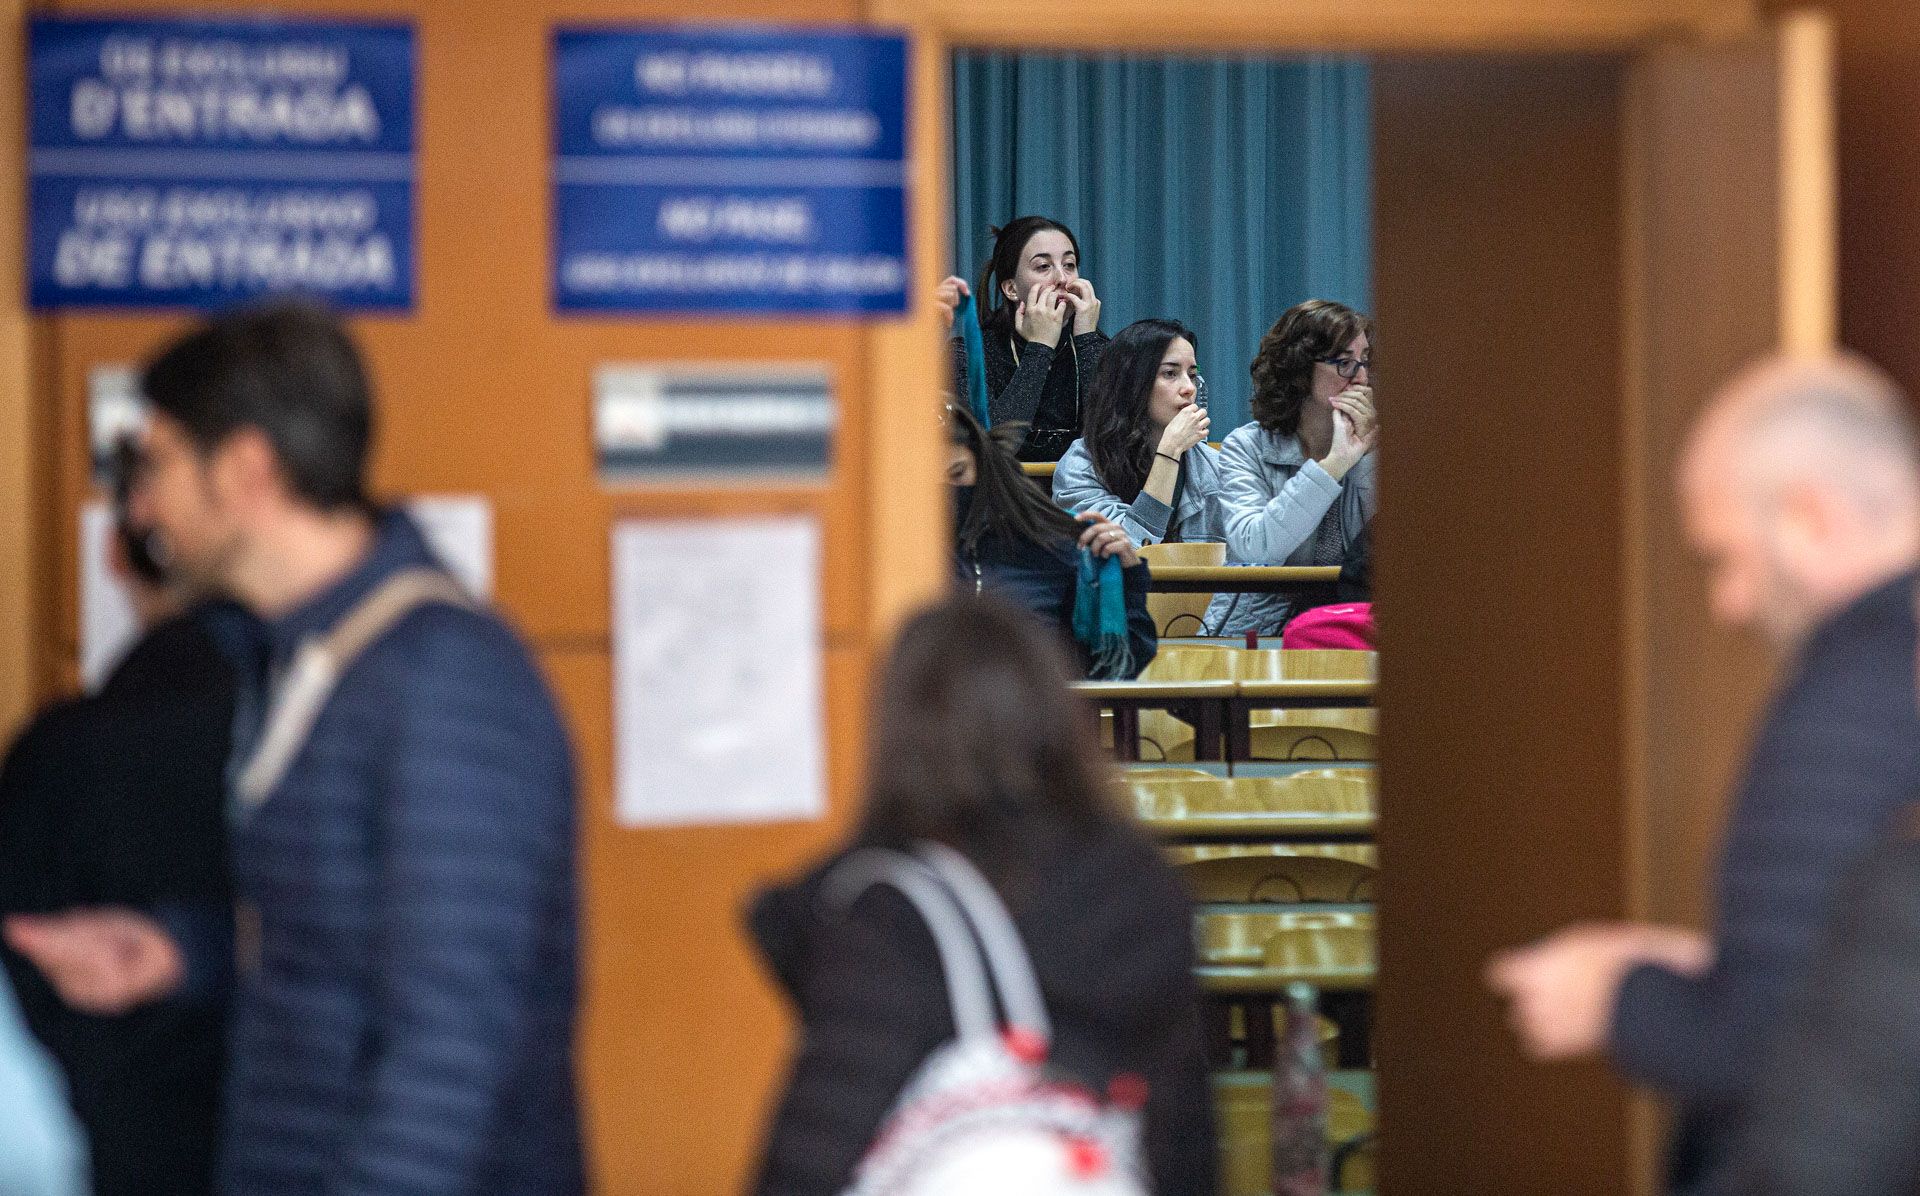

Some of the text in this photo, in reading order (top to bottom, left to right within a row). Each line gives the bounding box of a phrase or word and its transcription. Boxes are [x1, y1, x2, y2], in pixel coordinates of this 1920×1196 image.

[72, 78, 377, 140] D'ENTRADA
[56, 231, 391, 287] DE ENTRADA
